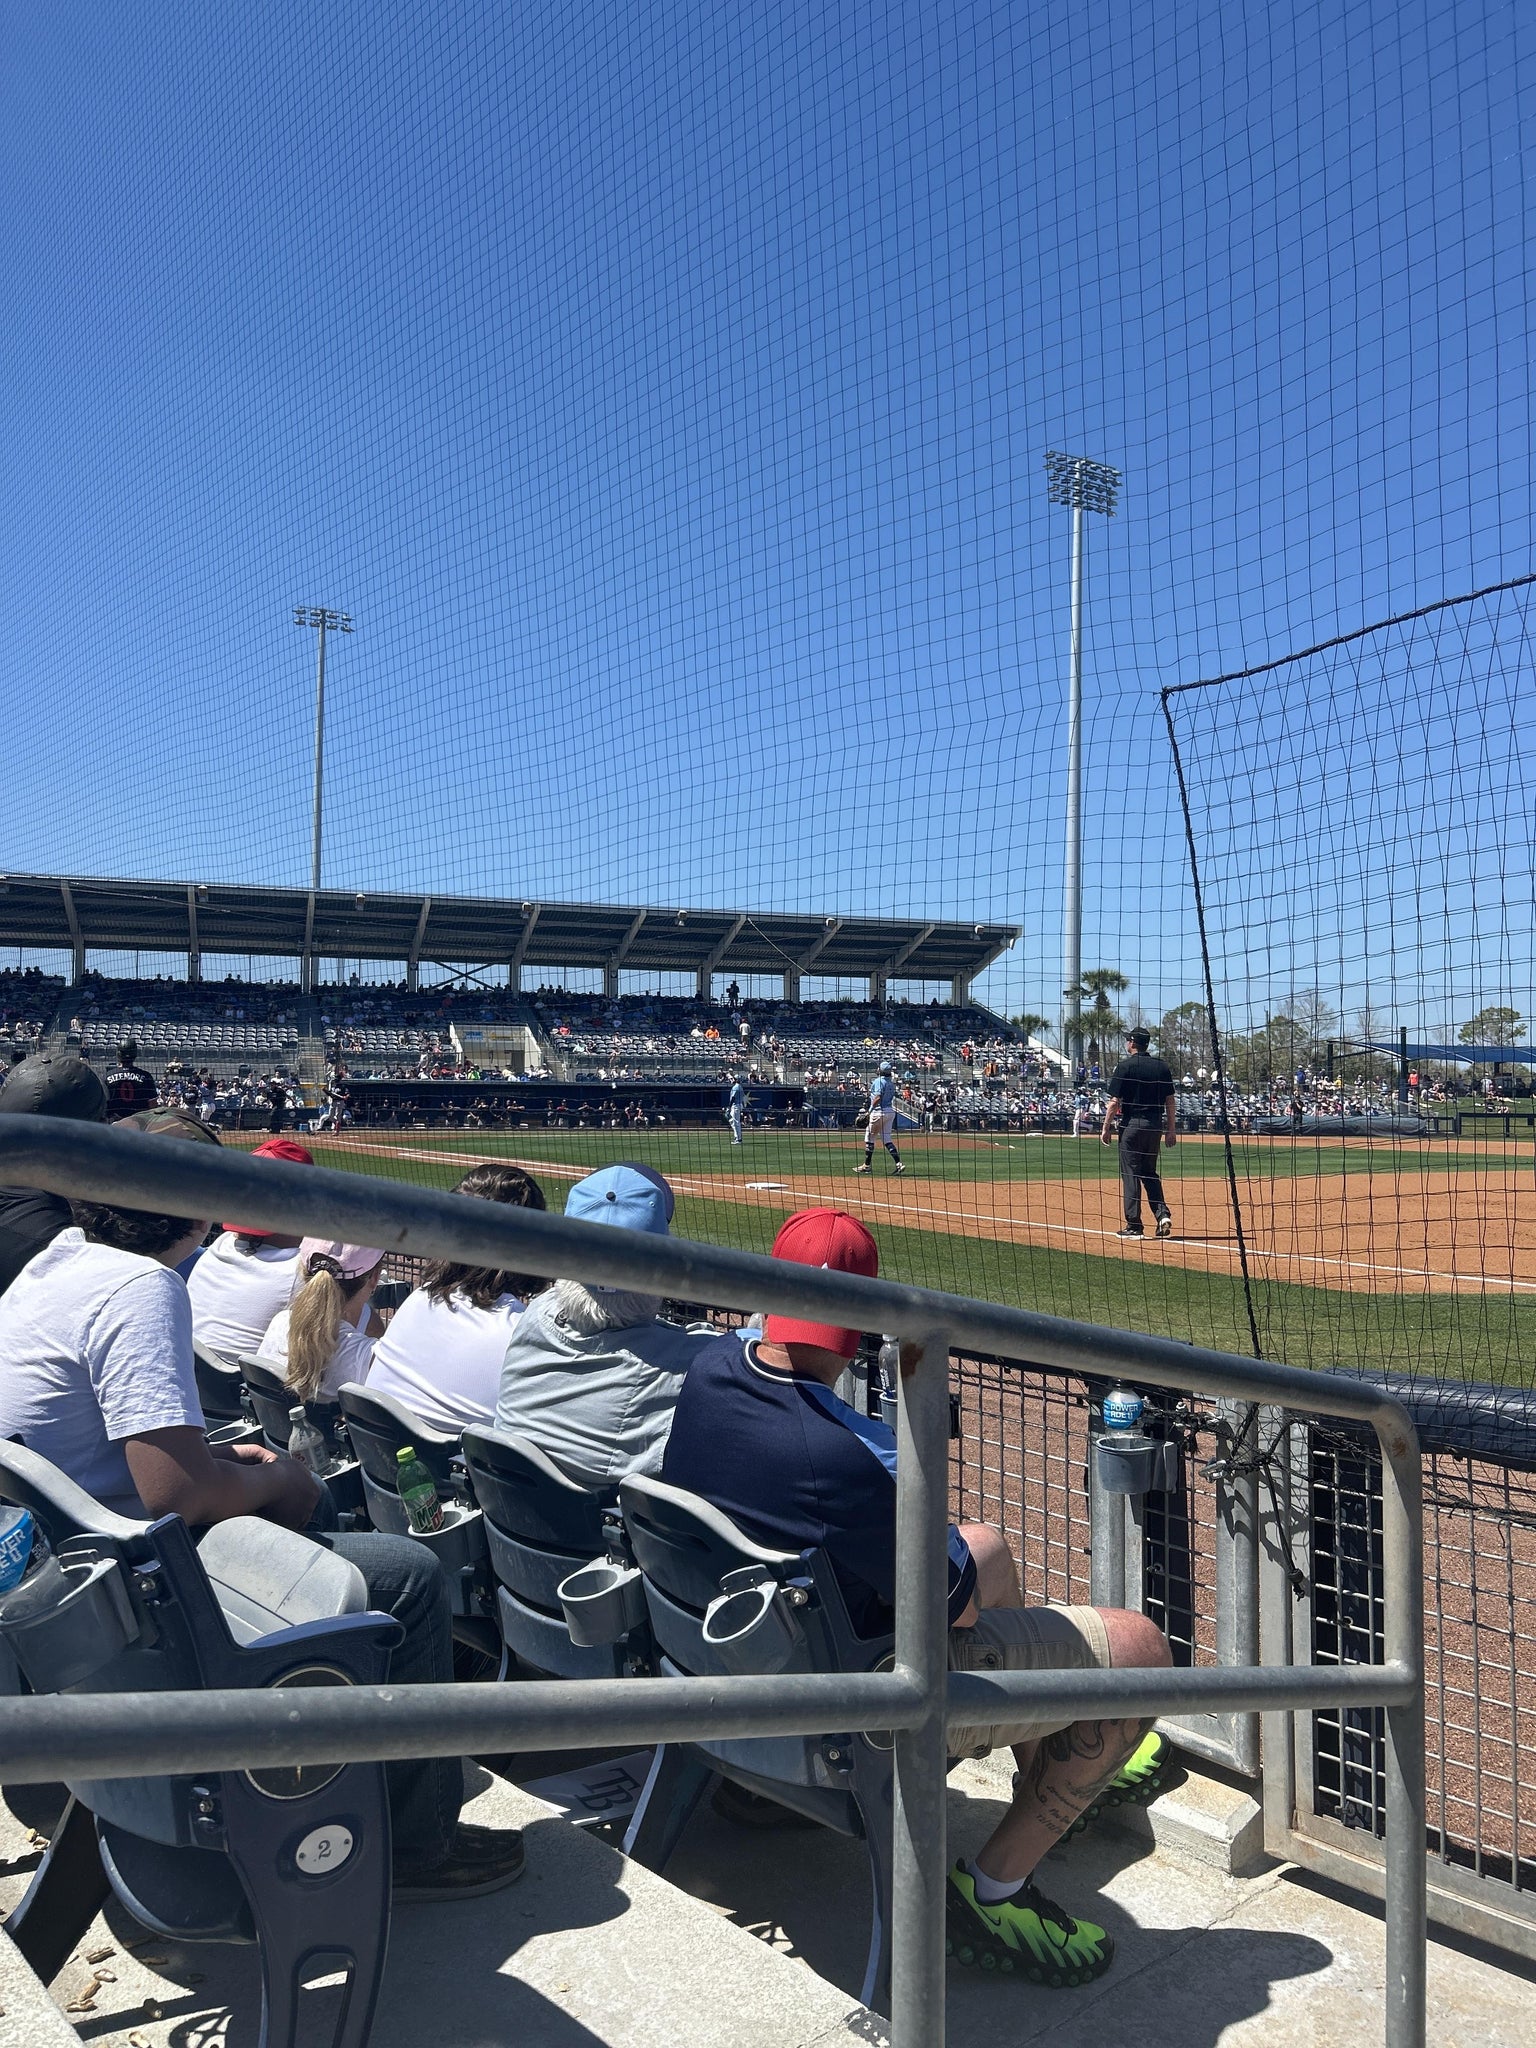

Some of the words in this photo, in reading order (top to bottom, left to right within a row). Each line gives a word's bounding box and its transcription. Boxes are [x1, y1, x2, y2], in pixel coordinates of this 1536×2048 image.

[106, 1072, 146, 1084] SIZEMORE
[1110, 1403, 1139, 1413] POWER
[574, 1767, 641, 1811] TB
[318, 1839, 332, 1860] 2
